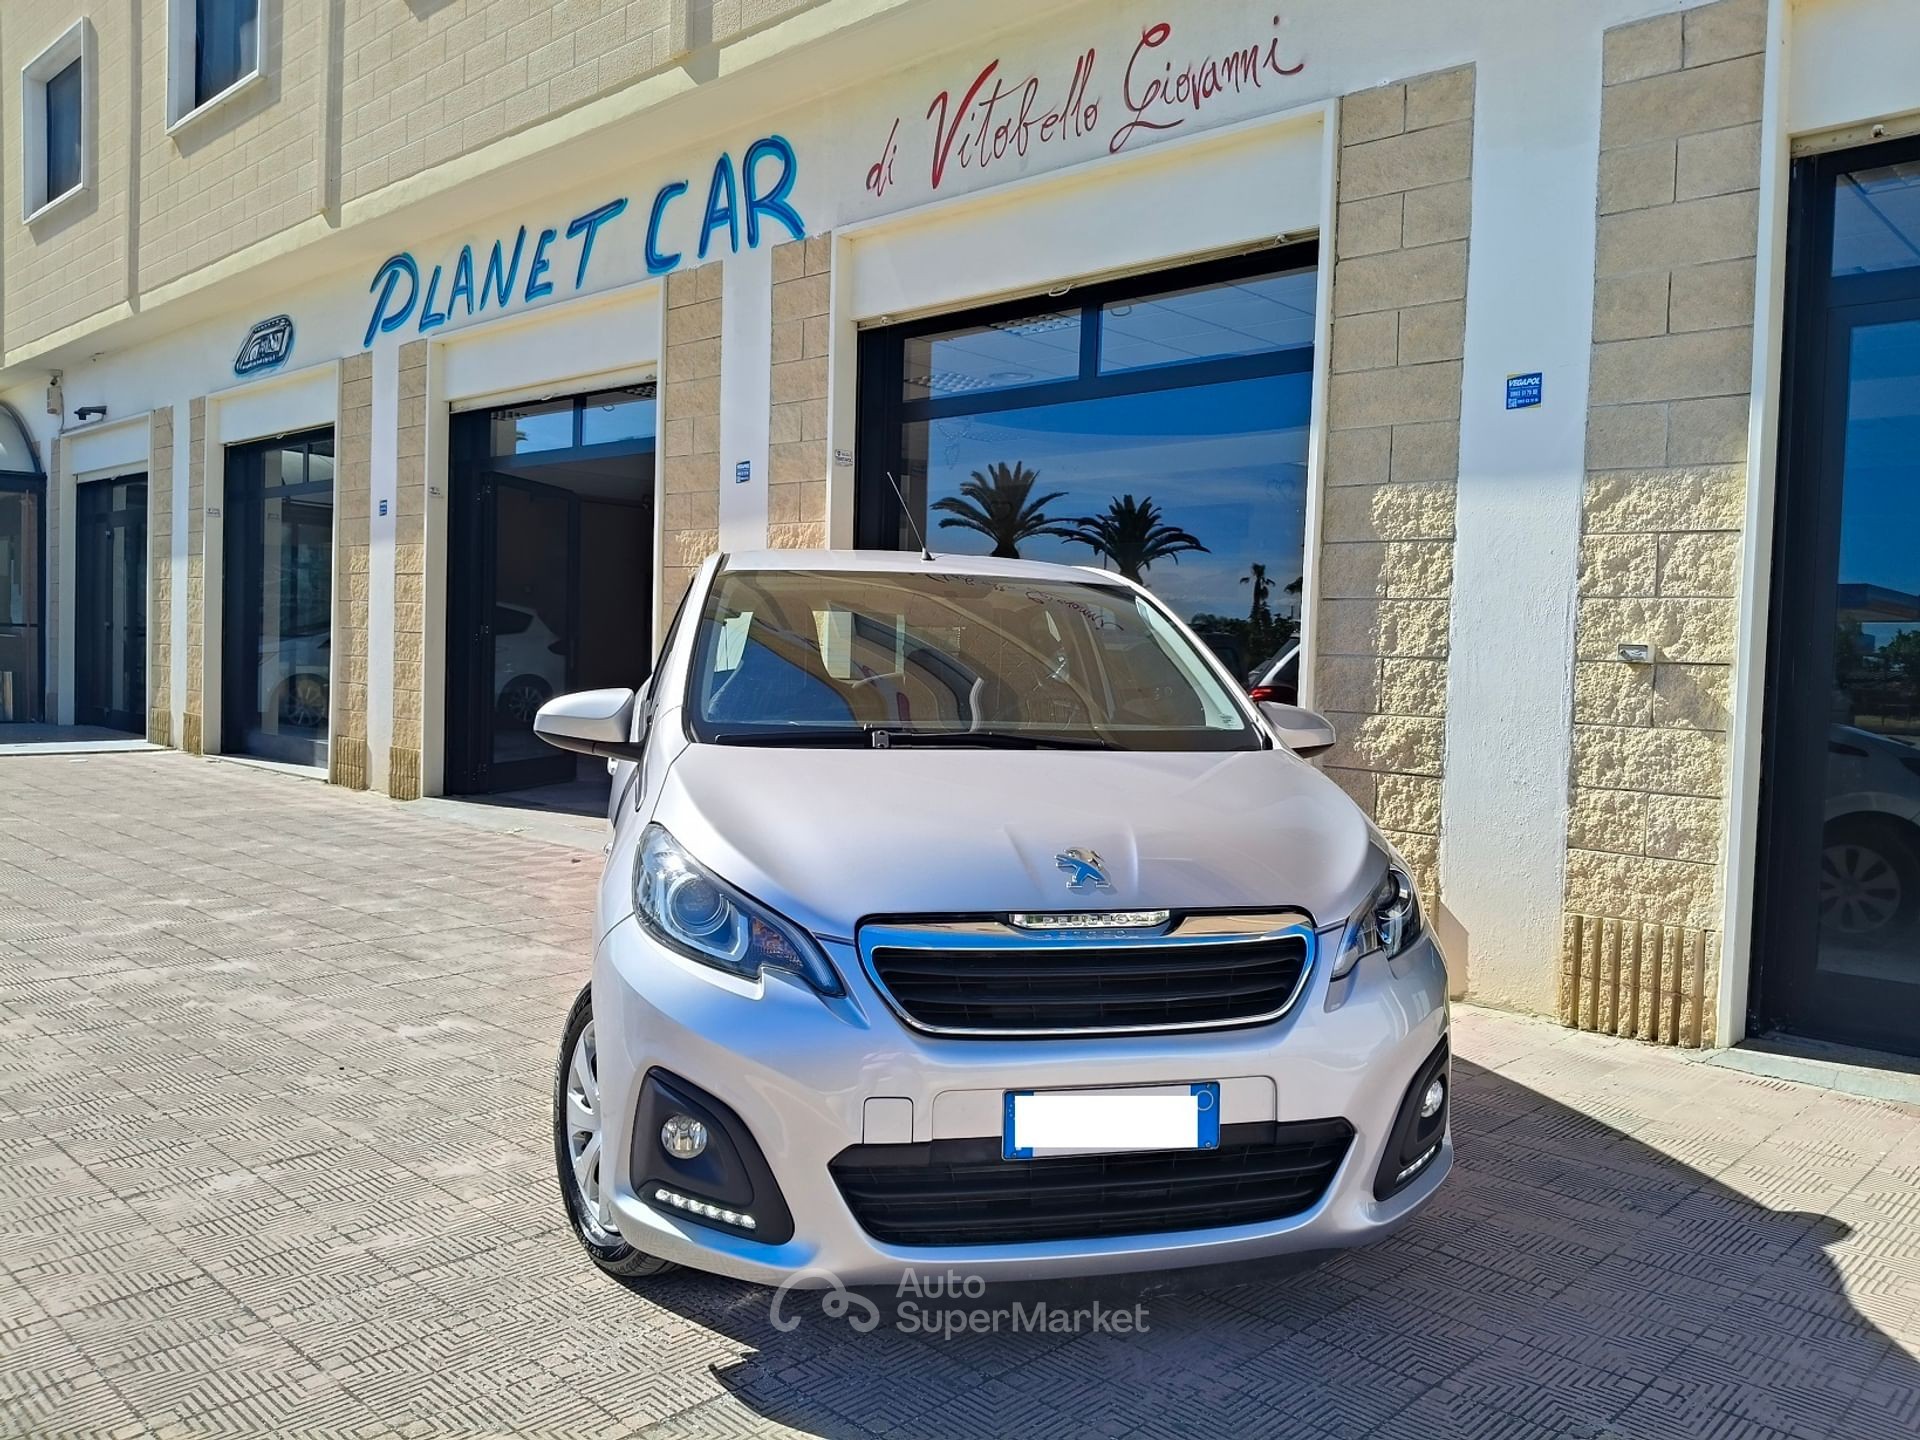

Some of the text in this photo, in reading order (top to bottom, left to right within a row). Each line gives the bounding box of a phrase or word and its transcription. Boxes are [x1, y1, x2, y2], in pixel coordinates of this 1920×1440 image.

[866, 15, 1304, 197] di Vitobello Giovanni
[363, 134, 806, 348] PLANET CAR
[1508, 376, 1541, 387] VEGAPOL
